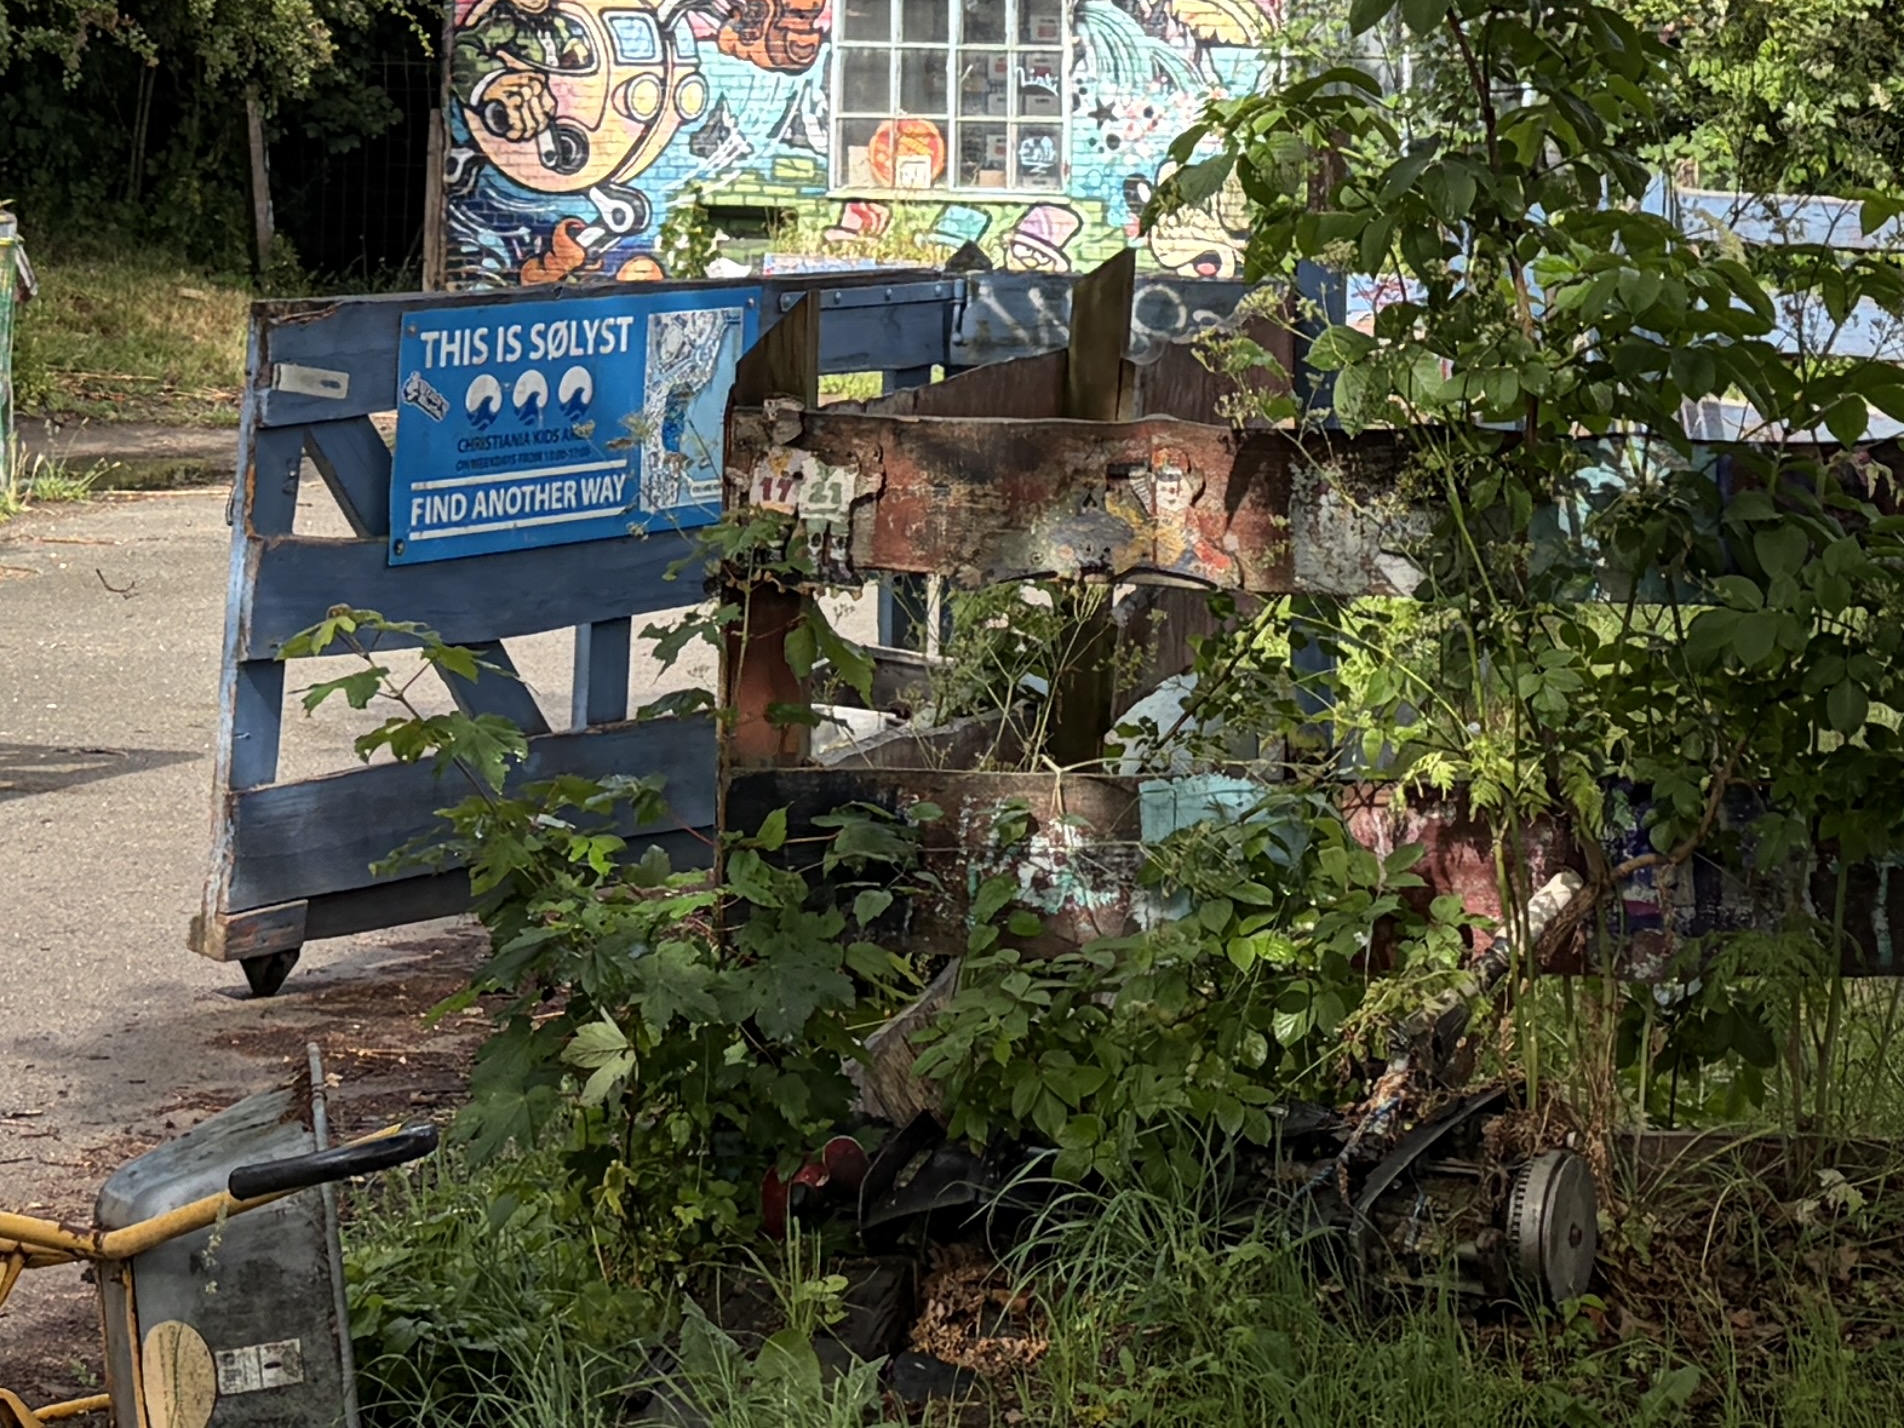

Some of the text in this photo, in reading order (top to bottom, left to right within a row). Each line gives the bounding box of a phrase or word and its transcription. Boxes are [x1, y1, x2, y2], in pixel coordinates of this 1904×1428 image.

[420, 316, 634, 369] THIS IS SØLYST
[410, 474, 626, 526] FIND ANOTHER WAY
[808, 482, 842, 504] 21
